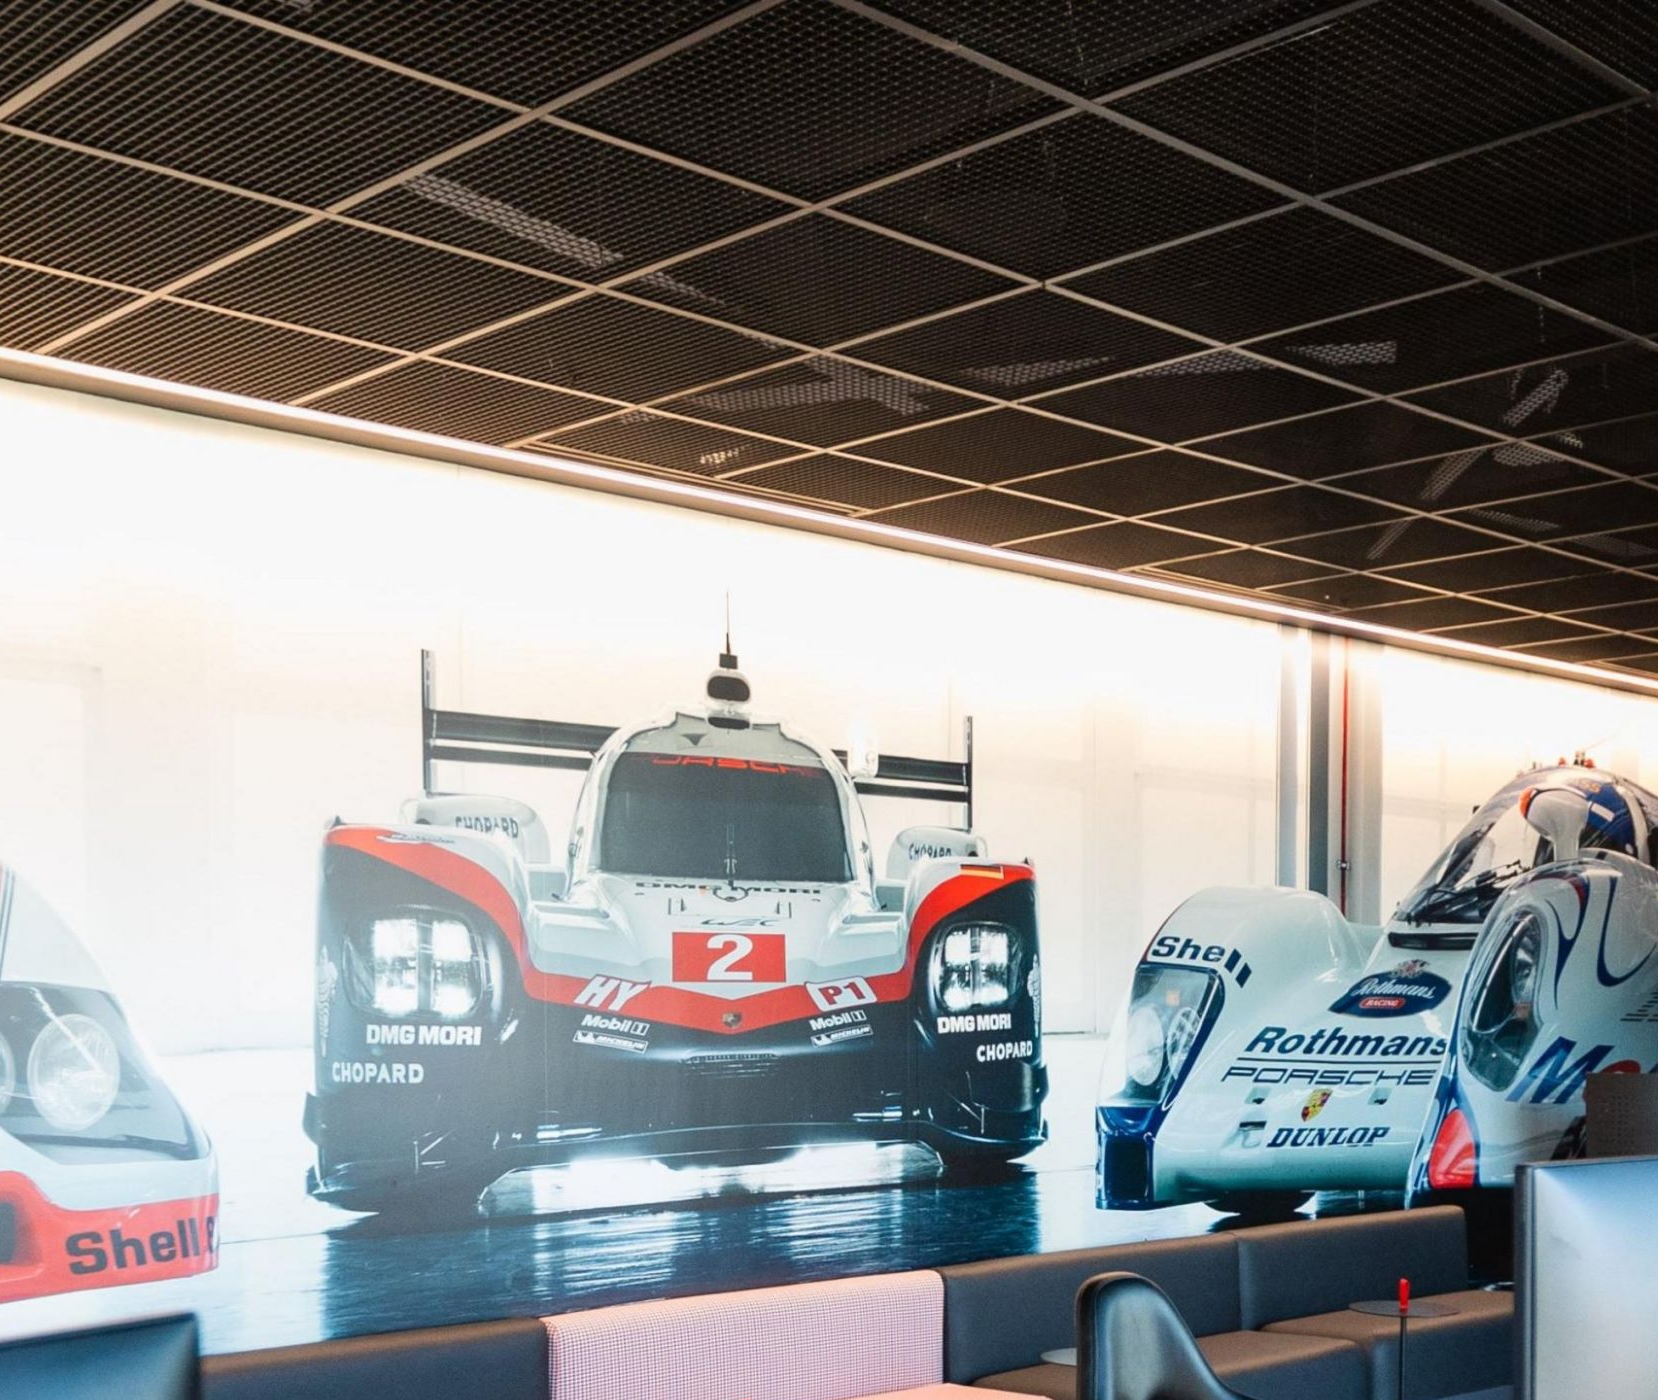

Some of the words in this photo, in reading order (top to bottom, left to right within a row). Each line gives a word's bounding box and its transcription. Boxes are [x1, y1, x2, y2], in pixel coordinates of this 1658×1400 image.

[707, 933, 753, 980] 2
[1151, 936, 1252, 988] Shell
[573, 974, 649, 1012] HY
[818, 981, 867, 1006] P1
[1350, 977, 1437, 999] Rothmans
[581, 1014, 632, 1033] Mobil
[809, 1012, 852, 1031] Mobil
[937, 1015, 975, 1034] DMG
[977, 1013, 1012, 1031] MORI
[366, 1024, 415, 1045] DMG
[418, 1025, 482, 1046] MORI
[1244, 1026, 1448, 1057] Rothmans
[976, 1040, 1033, 1062] CHOPARD
[332, 1062, 424, 1084] CHOPARD
[1221, 1066, 1437, 1085] PORSCHE
[1266, 1126, 1390, 1148] DUNLOP
[65, 1217, 200, 1276] Shell
